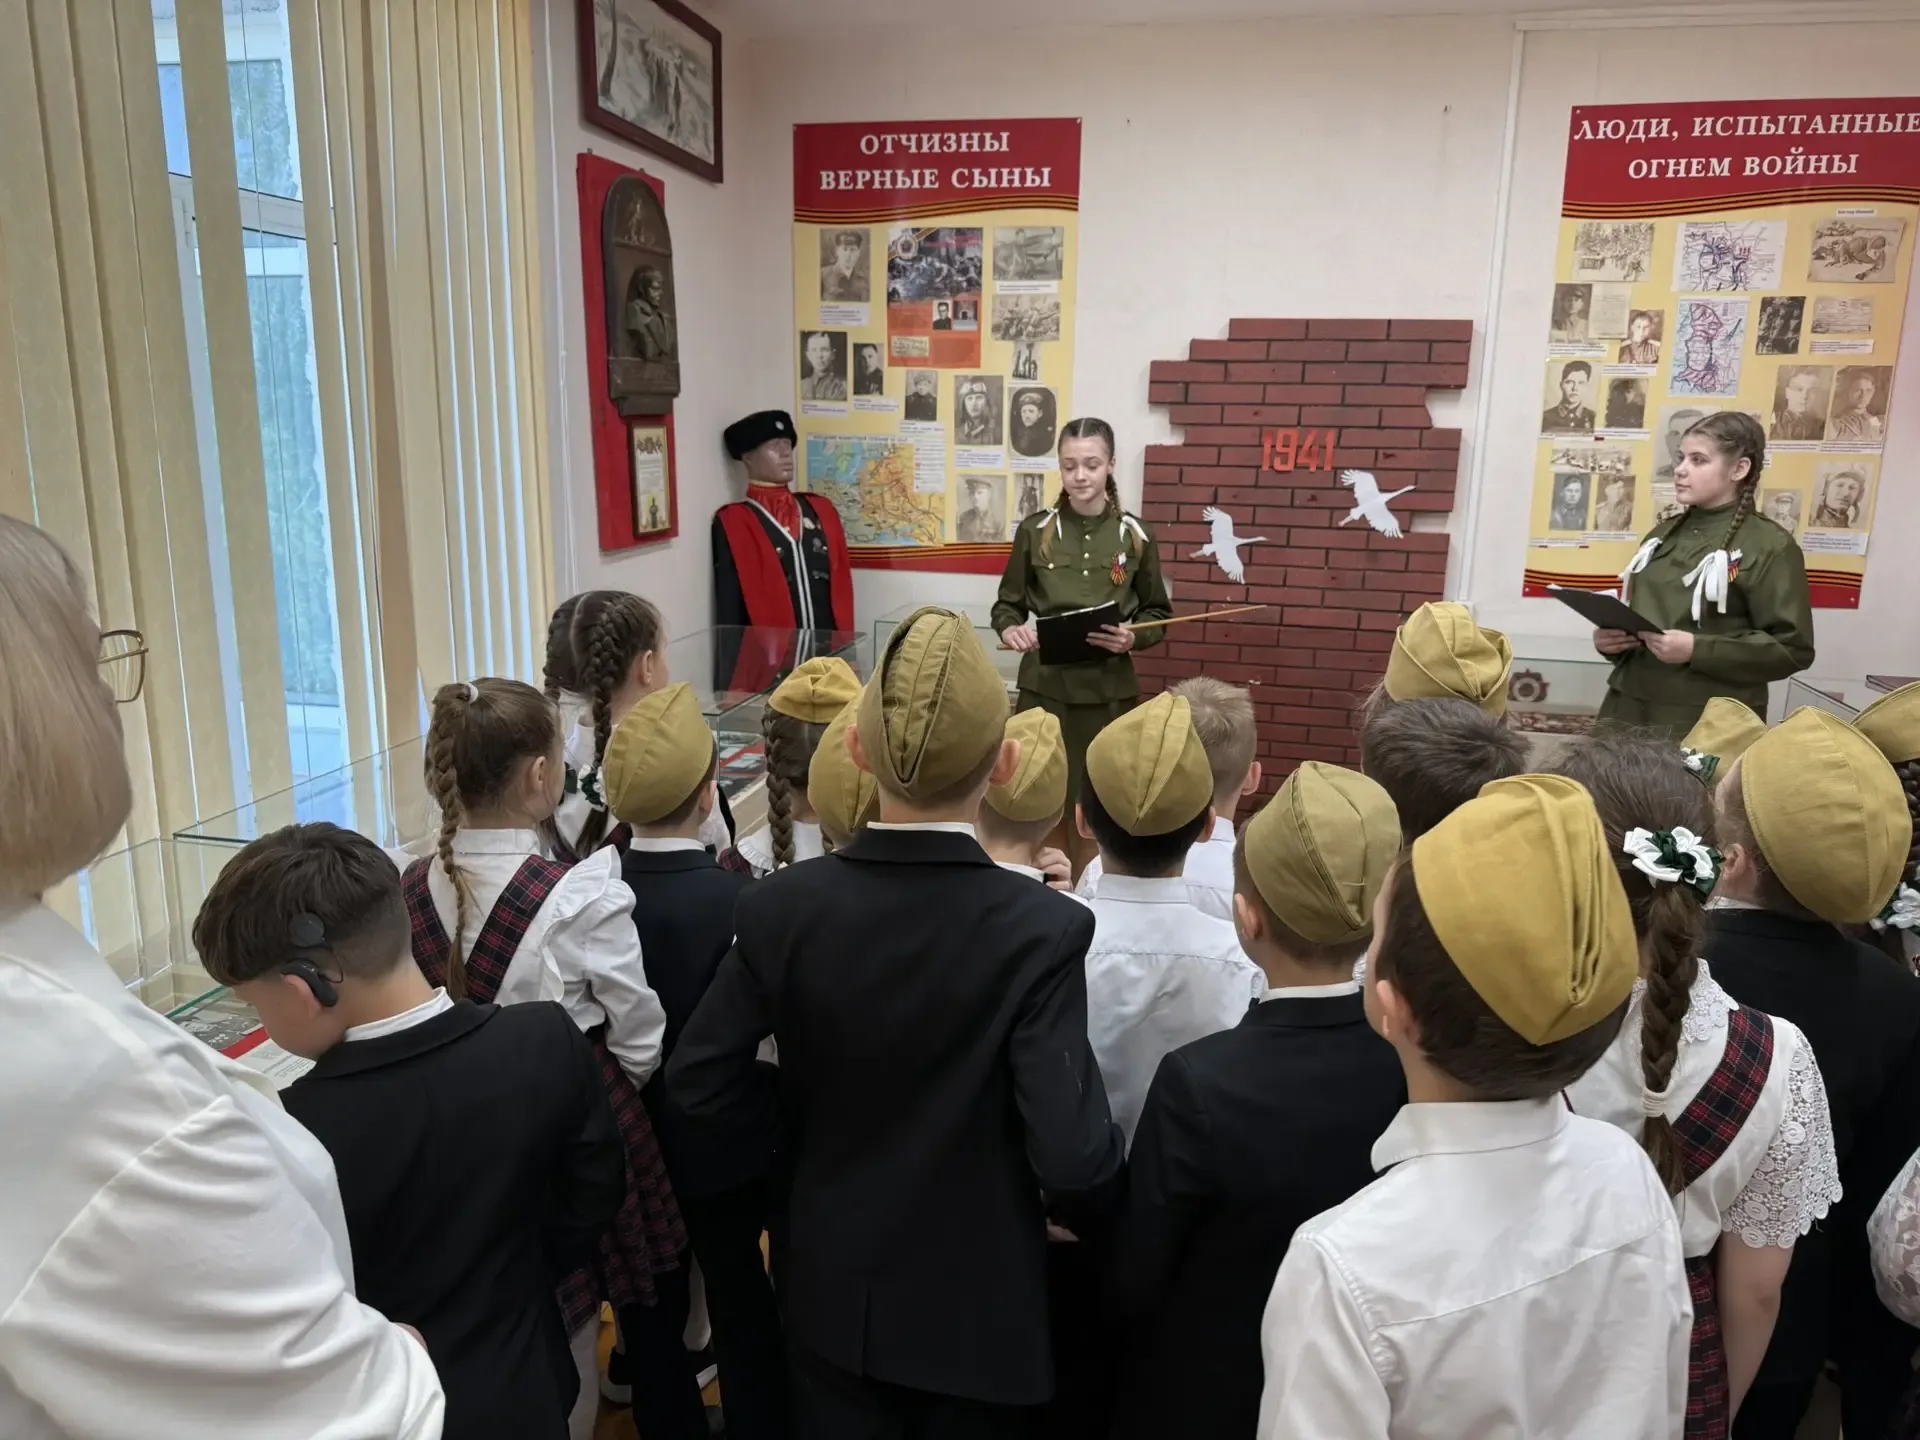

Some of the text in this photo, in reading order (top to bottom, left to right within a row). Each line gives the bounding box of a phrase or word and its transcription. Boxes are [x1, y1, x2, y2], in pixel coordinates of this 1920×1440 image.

[860, 132, 1010, 154] ОТЧИЗНЫ
[1574, 112, 1920, 143] ЛЮДИ, ИСПЫТАННЫЕ
[1628, 146, 1859, 179] ОГНЕМ ВОЙНЫ
[820, 167, 1052, 190] ВЕРНЫЕ СЫНЫ
[1261, 428, 1336, 473] 1941
